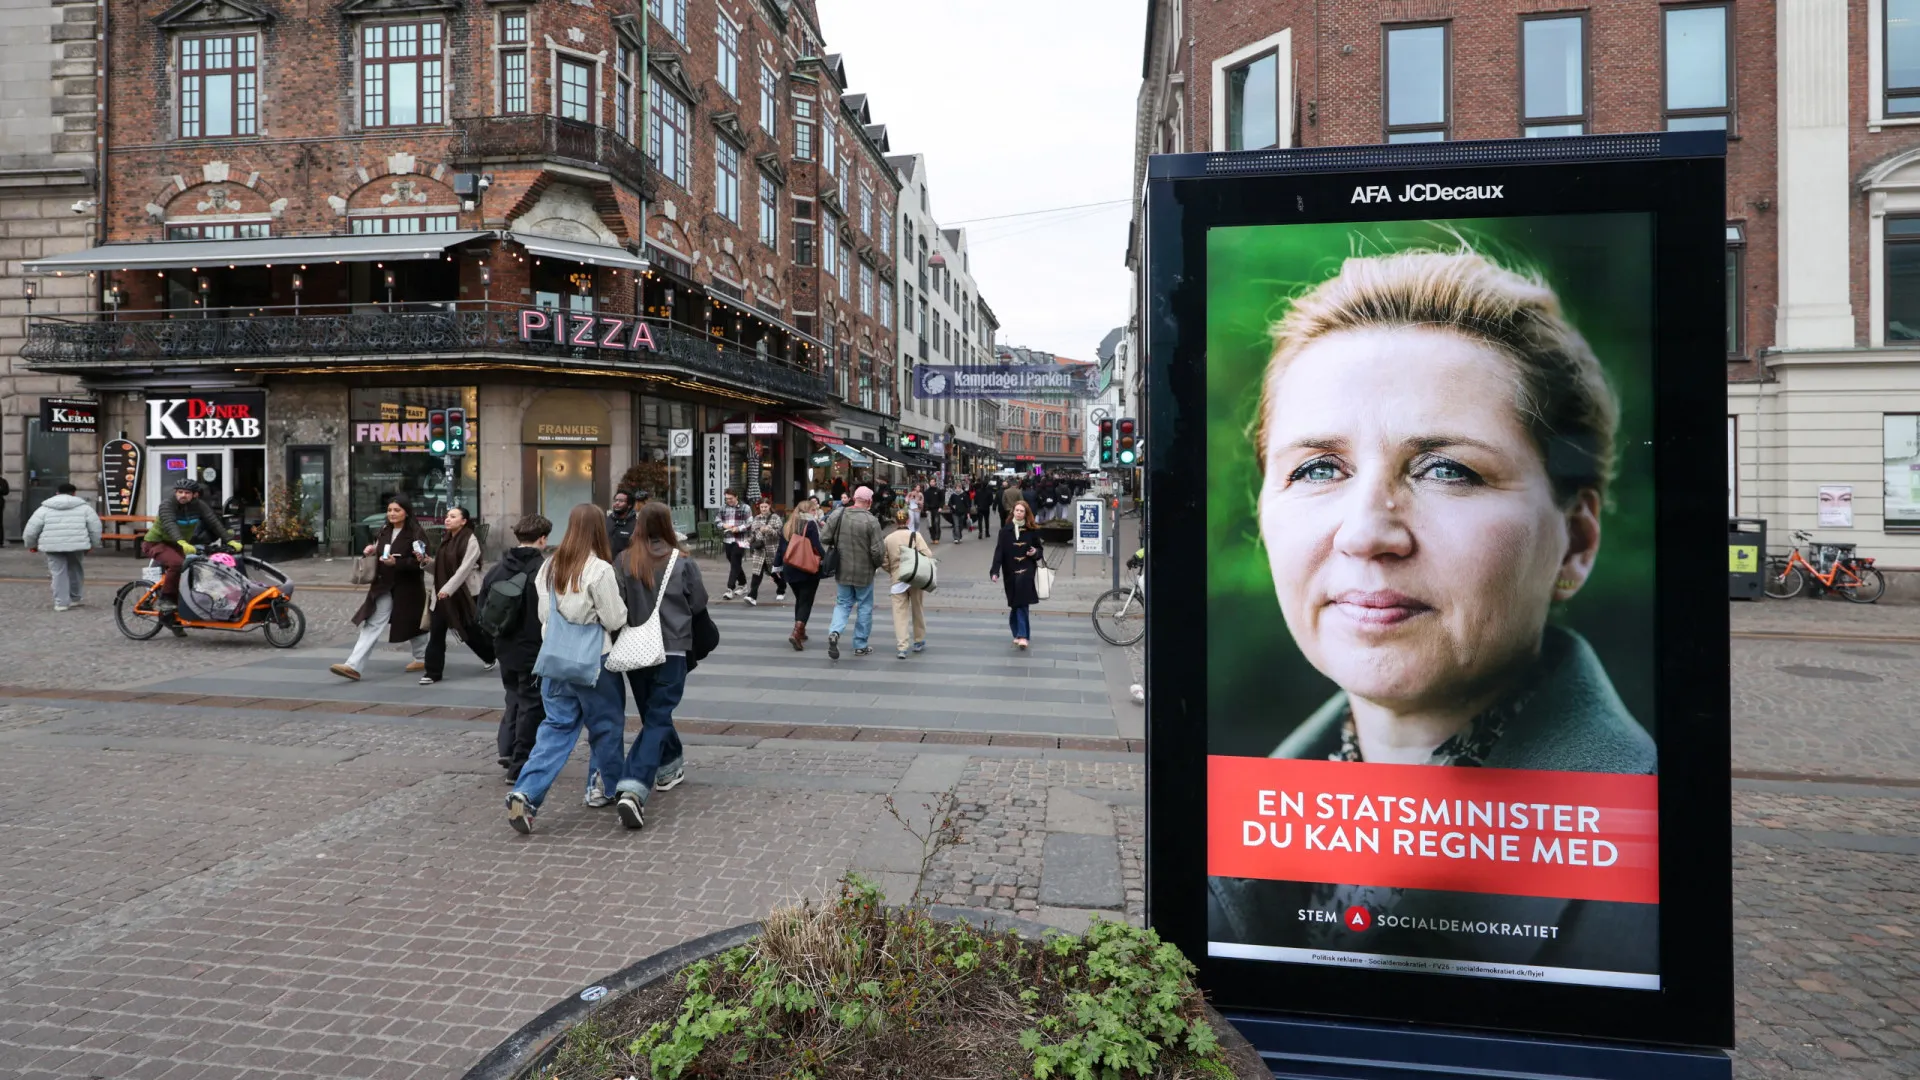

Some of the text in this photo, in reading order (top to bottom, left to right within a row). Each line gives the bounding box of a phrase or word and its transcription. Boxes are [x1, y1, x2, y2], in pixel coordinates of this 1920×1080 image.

[1350, 183, 1504, 204] AFA JCDecaux
[519, 309, 657, 353] PIZZA
[954, 370, 1071, 389] Kampdage i Parken
[52, 407, 96, 424] KEBAB
[145, 398, 261, 439] KEBAB
[356, 422, 472, 442] FRANK
[538, 424, 600, 435] FRANKIES
[708, 437, 716, 505] FRANKIES
[1258, 789, 1600, 833] EN STATSMINISTER
[1243, 820, 1618, 867] DU KAN REGNE MED
[1298, 909, 1559, 939] STEM A SOCIALDEMOKRATIET
[1368, 958, 1427, 968] Socialdemokratiet
